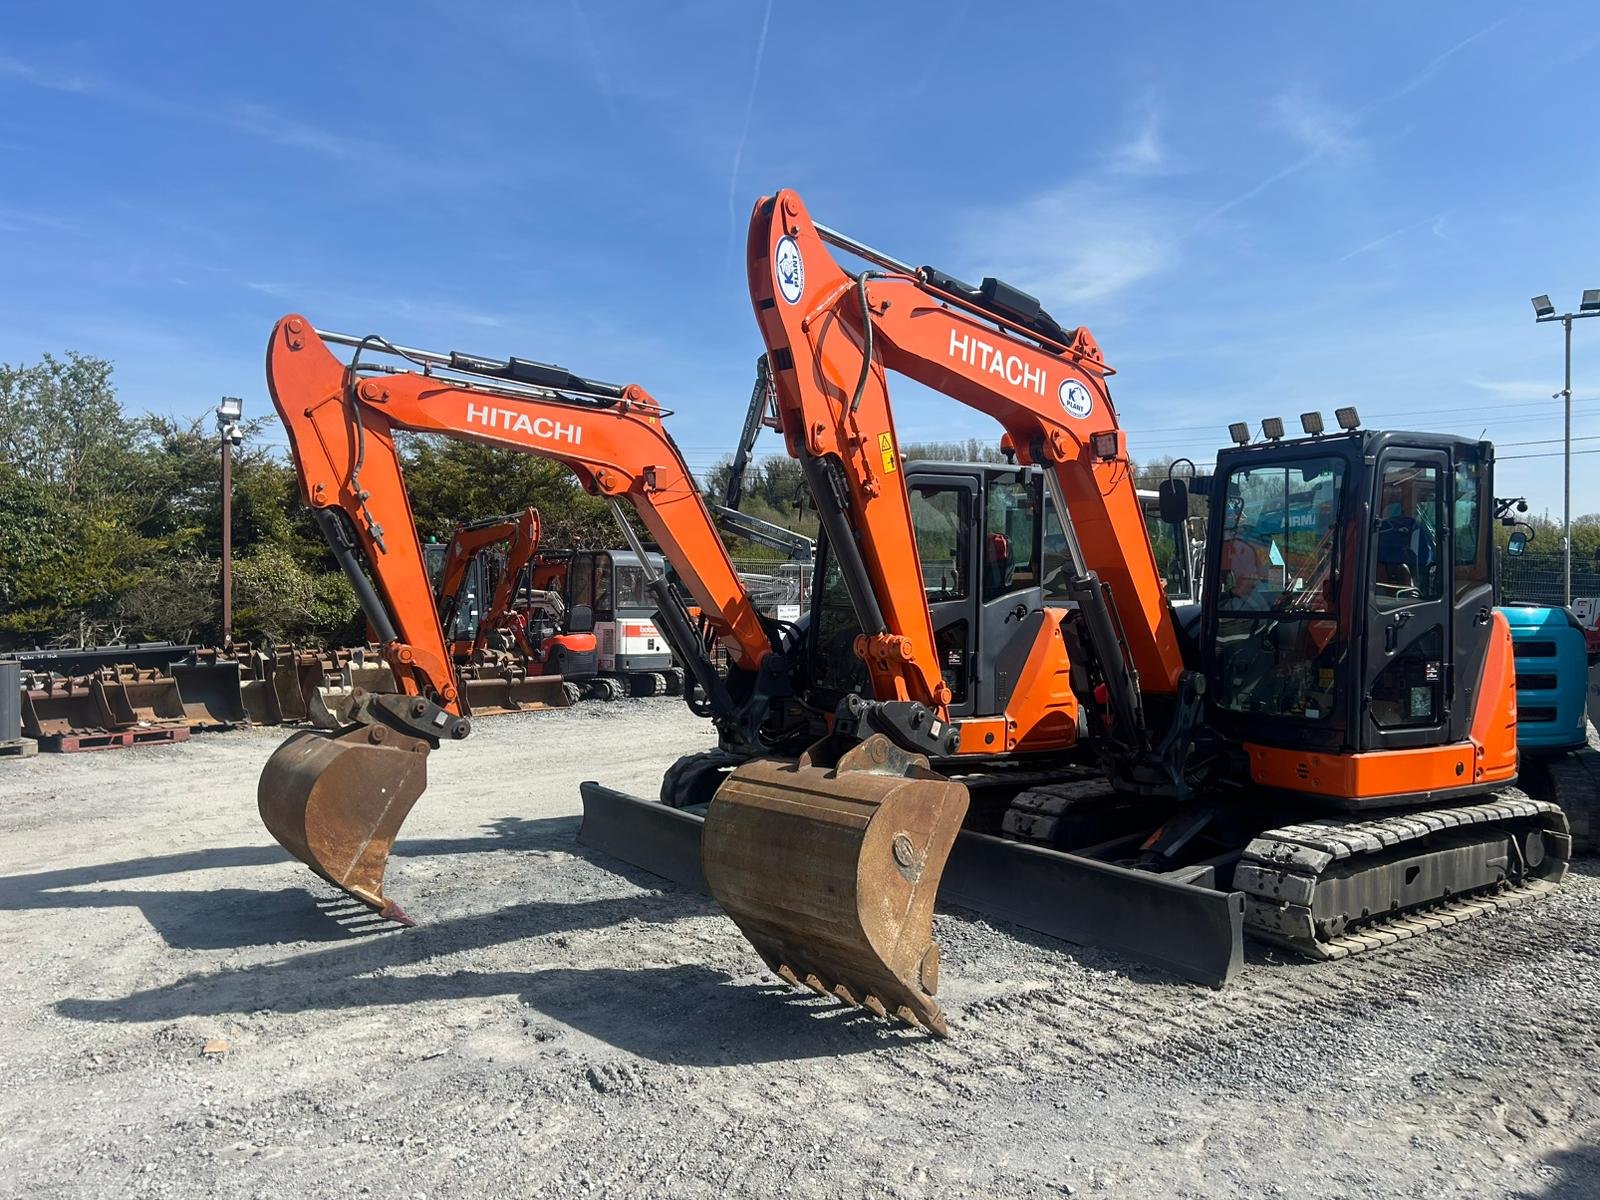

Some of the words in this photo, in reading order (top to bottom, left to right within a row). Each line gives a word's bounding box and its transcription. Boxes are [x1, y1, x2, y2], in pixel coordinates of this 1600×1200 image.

[791, 253, 800, 288] PLANT
[949, 328, 1047, 397] HITACHI
[466, 402, 582, 445] HITACHI
[1066, 399, 1084, 413] PLANT
